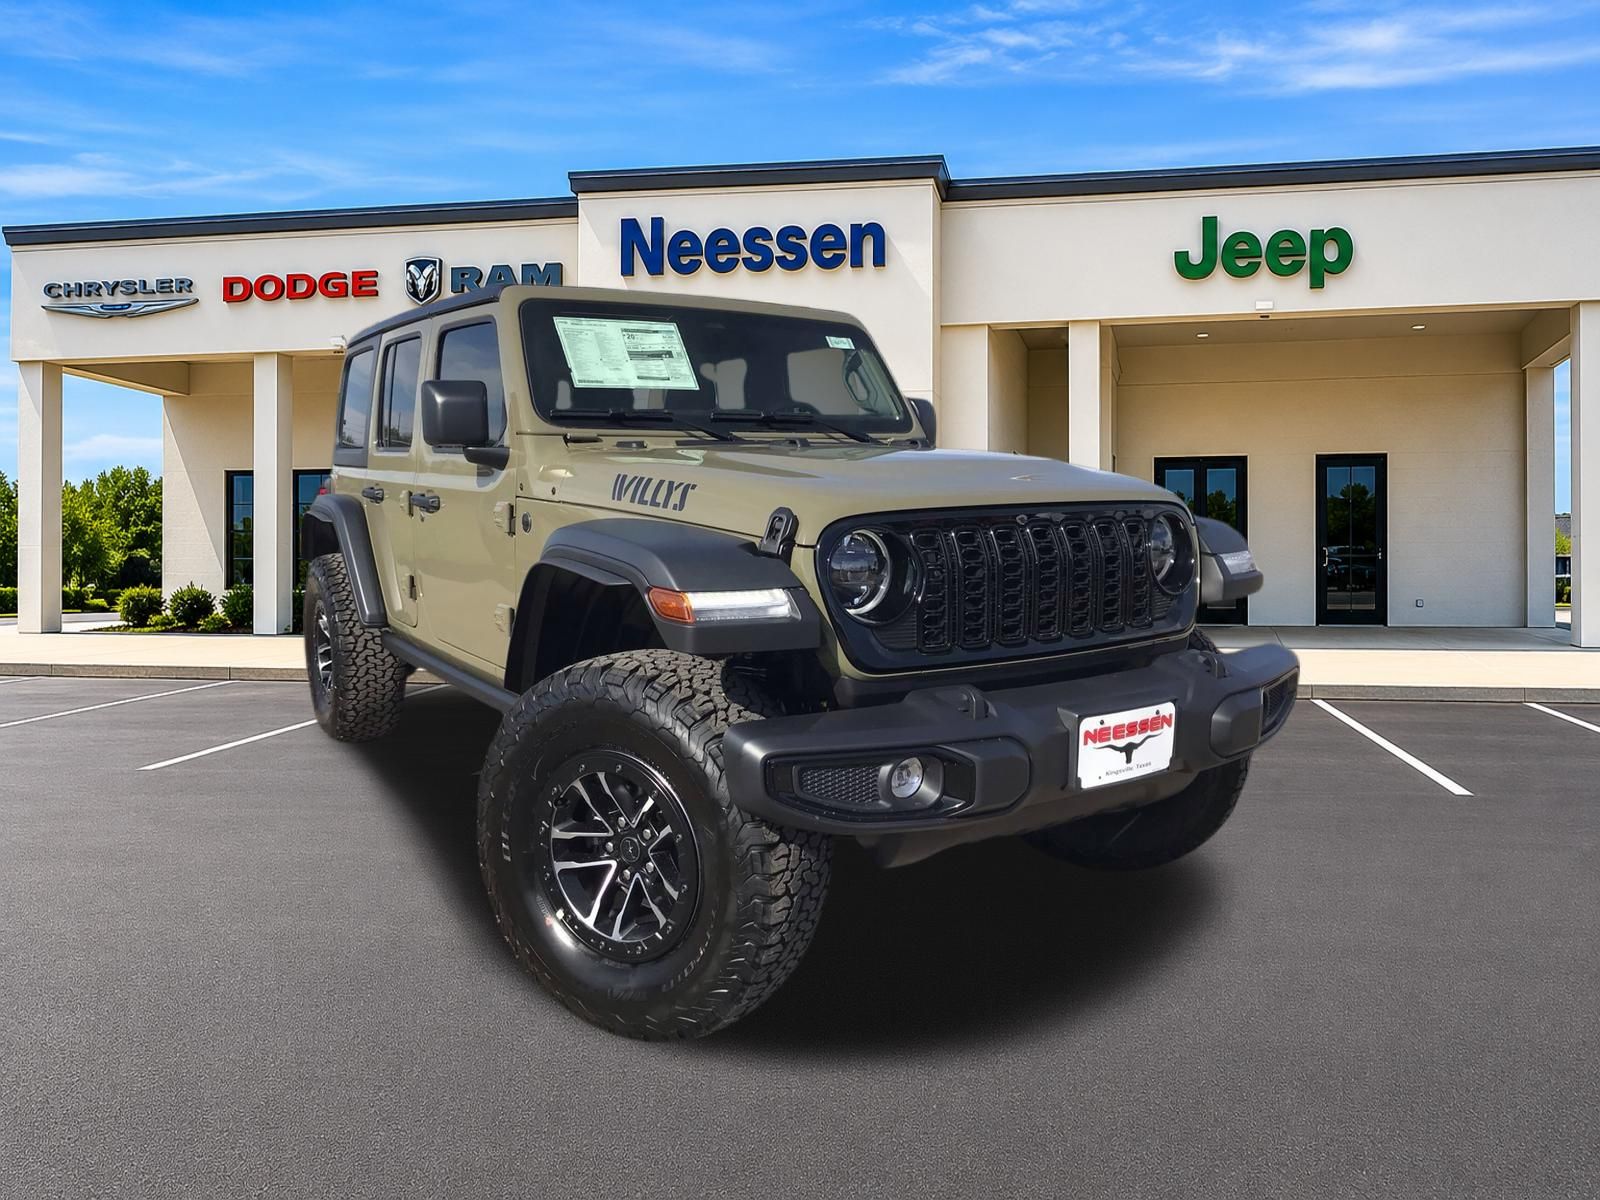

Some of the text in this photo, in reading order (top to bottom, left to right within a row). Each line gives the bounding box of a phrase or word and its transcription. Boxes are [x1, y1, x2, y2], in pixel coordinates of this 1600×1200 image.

[620, 216, 886, 276] Neessen
[1174, 215, 1354, 289] Jeep
[43, 276, 194, 299] CHRYSLER
[222, 270, 379, 303] DODGE
[450, 262, 563, 293] RAM
[611, 473, 697, 512] WILLYS
[1083, 713, 1173, 746] NEESSEN
